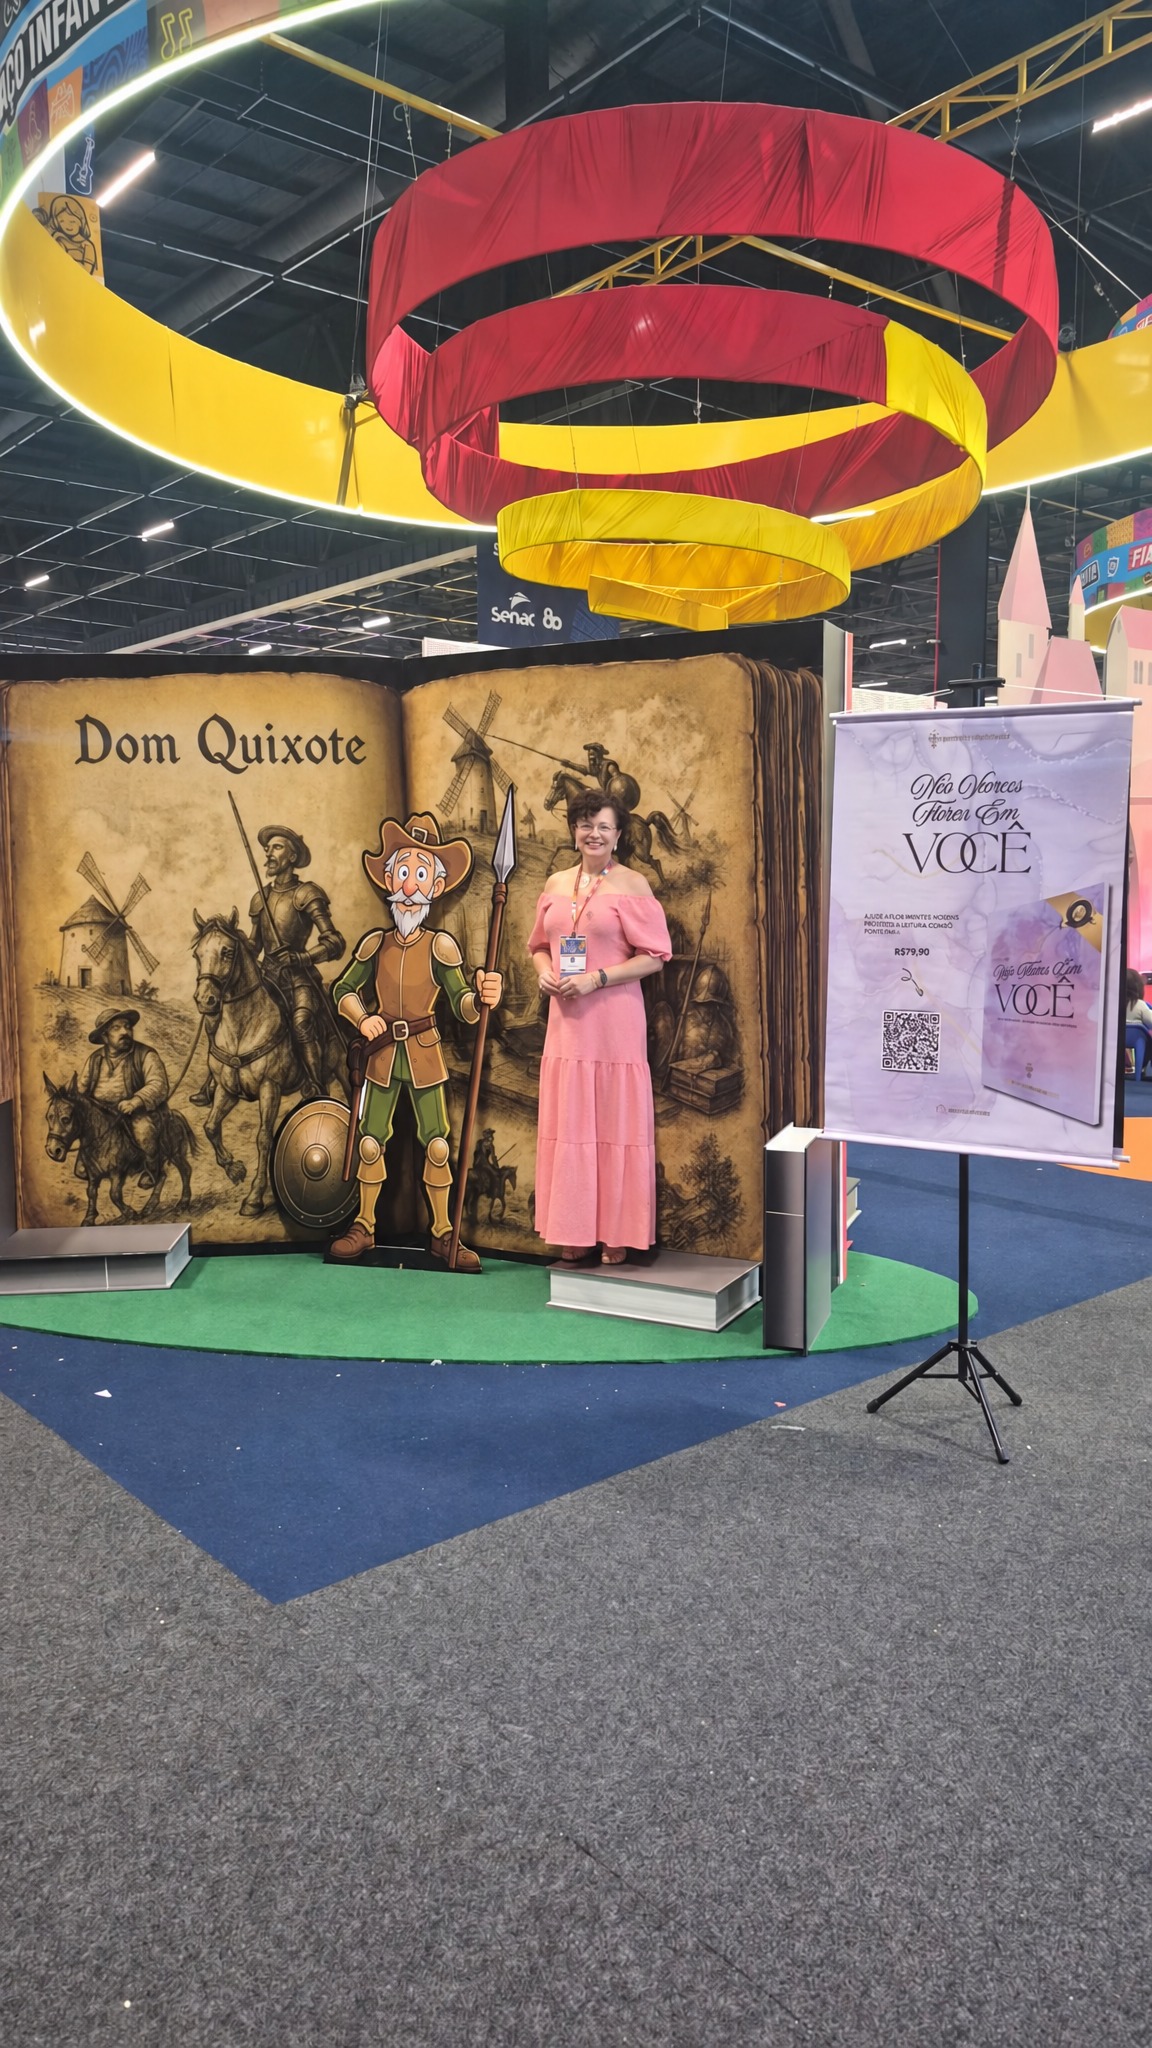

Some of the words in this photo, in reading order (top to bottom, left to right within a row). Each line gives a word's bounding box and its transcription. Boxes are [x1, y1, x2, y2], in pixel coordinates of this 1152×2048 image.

[491, 606, 535, 627] Senac
[75, 714, 181, 765] Dom
[197, 713, 367, 775] Quixote
[902, 820, 1031, 874] VOCÊ
[894, 948, 930, 957] R$79,90
[995, 976, 1075, 1019] VOCÊ
